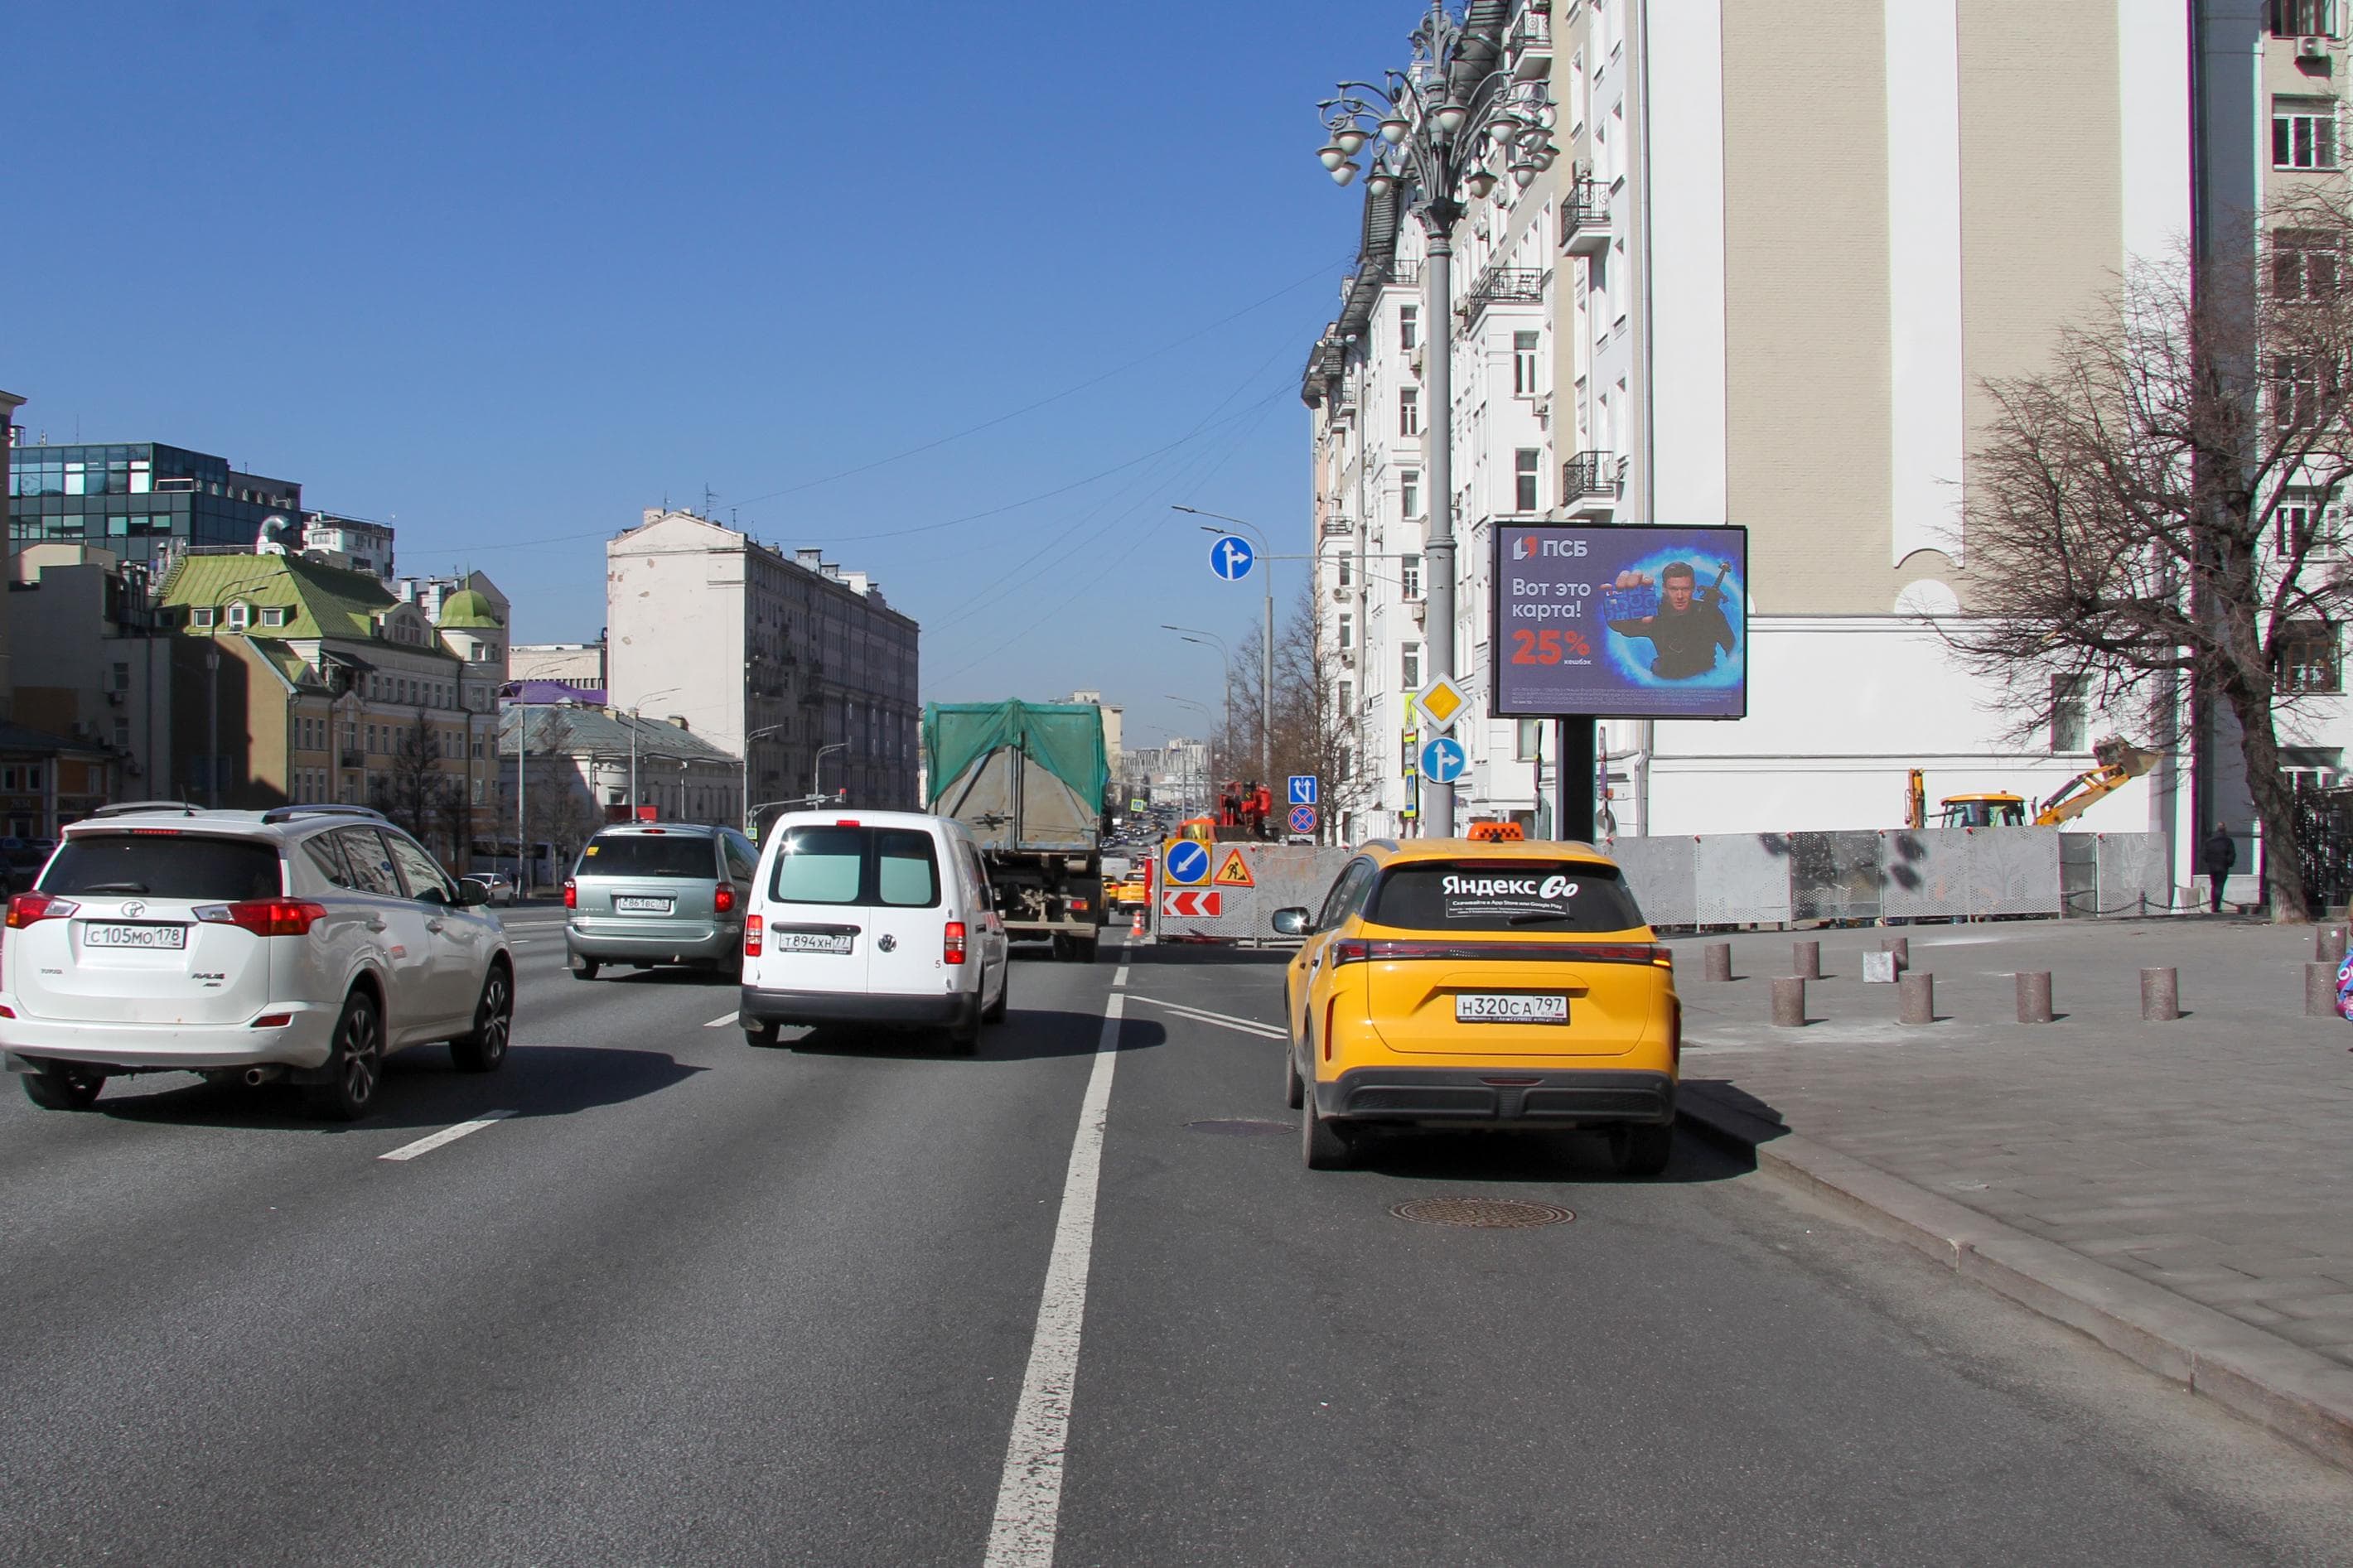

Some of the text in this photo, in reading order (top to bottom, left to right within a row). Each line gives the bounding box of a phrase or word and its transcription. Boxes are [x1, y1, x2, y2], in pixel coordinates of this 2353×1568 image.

[1543, 539, 1588, 557] ПСБ
[1513, 578, 1592, 596] Вот это
[1512, 601, 1582, 622] карта!
[1511, 629, 1591, 665] 25%
[1442, 876, 1579, 900] Яндекс Go
[1550, 902, 1563, 910] Play
[90, 927, 180, 944] С105МО 178
[935, 959, 941, 969] 5
[1462, 997, 1563, 1016] Н320СА 797
